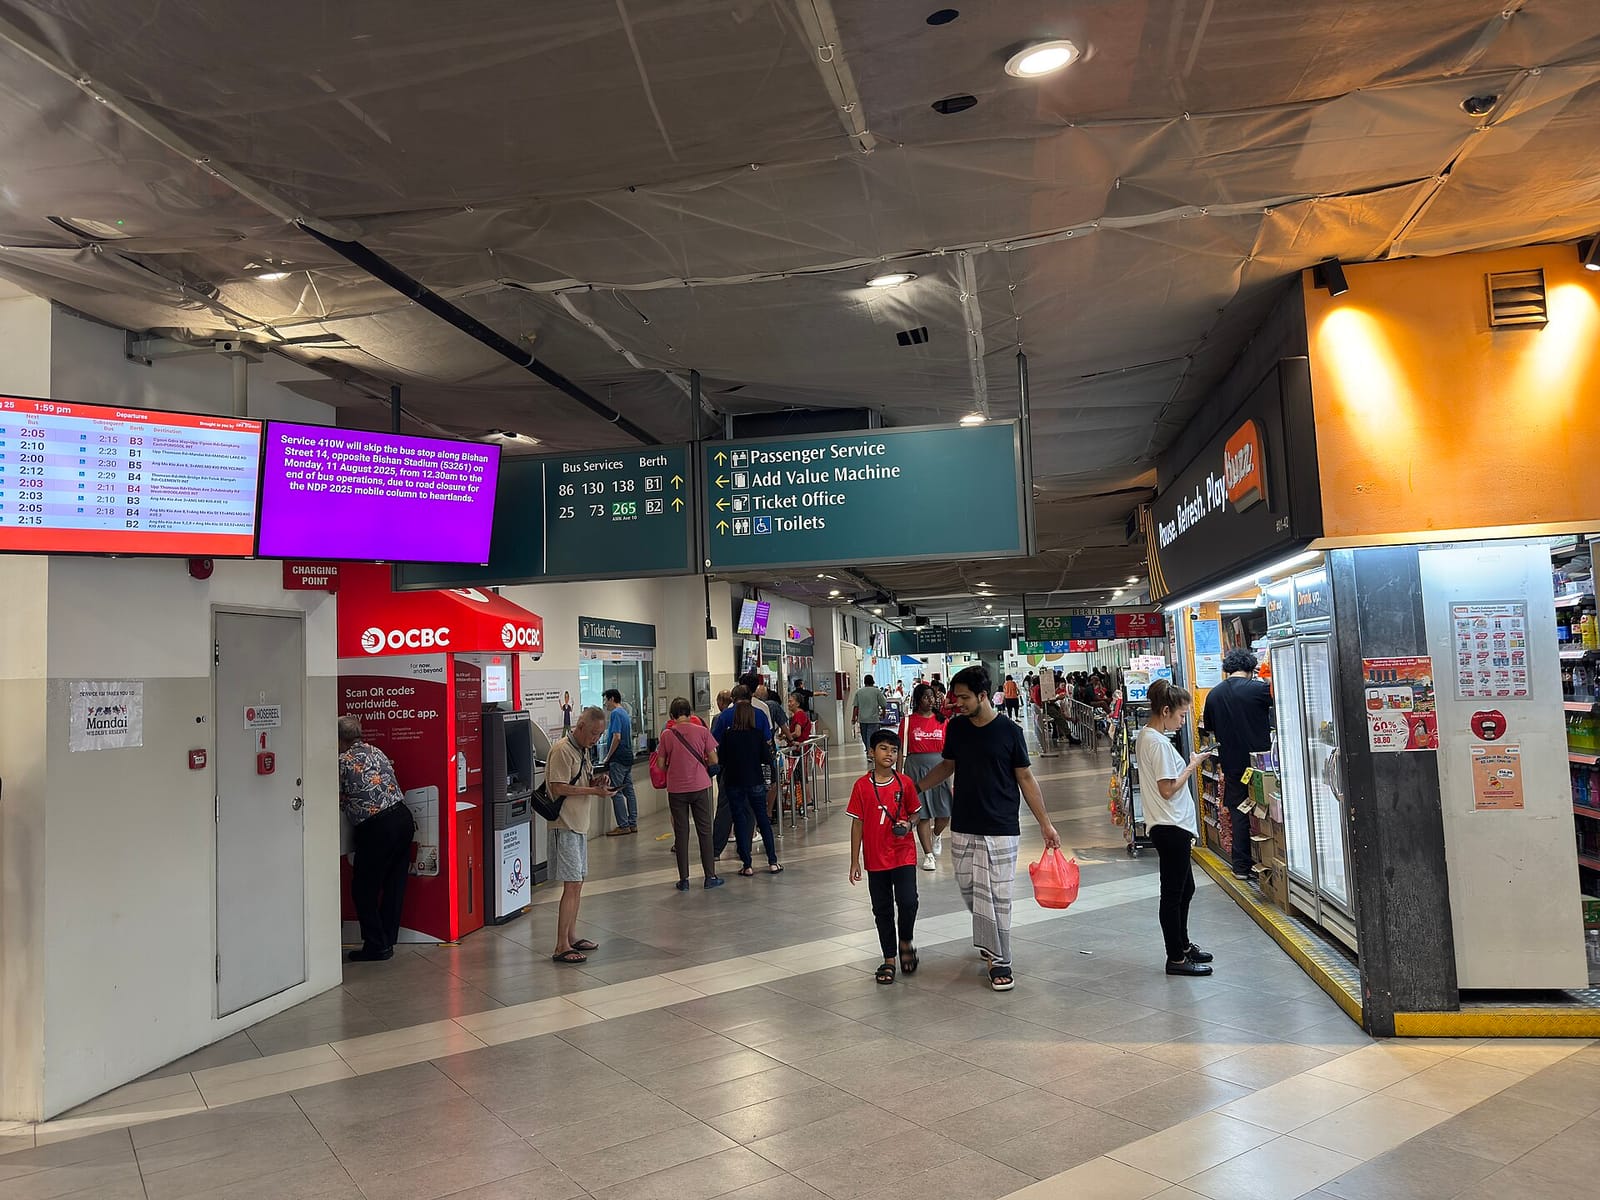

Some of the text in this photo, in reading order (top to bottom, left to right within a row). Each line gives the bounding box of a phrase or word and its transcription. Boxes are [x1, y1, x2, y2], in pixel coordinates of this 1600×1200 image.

[34, 404, 54, 412] 1:59
[20, 428, 45, 438] 2:05
[99, 435, 118, 443] 2:15
[130, 437, 143, 446] B3
[20, 441, 141, 458] 2:10 2:23 B1
[280, 434, 488, 462] Service 410W will skip the bus stop along Bishan
[751, 441, 886, 464] Passenger Service
[20, 454, 44, 463] 2:00
[129, 461, 142, 469] B5
[285, 447, 314, 457] Street
[316, 450, 330, 460] 14,
[332, 453, 370, 462] opposite
[373, 455, 402, 464] Bishan
[404, 458, 438, 468] Stadium
[440, 461, 472, 472] (53261)
[562, 460, 624, 472] Bus Services
[640, 455, 668, 468] Berth
[20, 466, 44, 476] 2:12
[284, 458, 324, 471] Monday,
[326, 462, 337, 470] 11
[340, 463, 371, 473] August
[374, 466, 398, 477] 2025,
[400, 468, 420, 477] from
[422, 470, 458, 480] 12.30am
[752, 464, 900, 487] Add Value Machine
[19, 479, 43, 488] 2:03
[128, 485, 141, 493] B4
[286, 471, 304, 479] end
[306, 471, 316, 479] of
[318, 472, 334, 481] bus
[336, 475, 385, 486] operations,
[387, 478, 403, 486] due
[436, 482, 466, 491] closure
[468, 484, 479, 492] for
[559, 479, 660, 496] 86 130 138 B1
[19, 491, 43, 500] 2:03
[290, 481, 304, 490] the
[307, 482, 327, 491] NDP
[330, 485, 352, 494] 2025
[355, 486, 384, 496] mobile
[386, 489, 417, 498] column
[430, 492, 474, 502] heartlands.
[19, 504, 42, 512] 2:05
[752, 491, 846, 510] Ticket Office
[559, 502, 661, 519] 25 73 265 B2
[1158, 472, 1228, 550] Pause. Refresh. Play.
[18, 516, 42, 524] 2:15
[126, 520, 139, 528] B2
[774, 515, 825, 532] Toilets
[292, 566, 337, 575] CHARGING
[302, 577, 328, 585] POINT
[1038, 618, 1060, 628] 265
[1085, 616, 1101, 626] 73
[1130, 614, 1146, 624] 25
[387, 627, 450, 648] OCBC
[517, 628, 540, 646] OCBC
[590, 623, 621, 638] Ticket office
[346, 686, 415, 697] Scan QR codes
[346, 699, 399, 709] worldwide.
[366, 711, 385, 720] with
[388, 709, 415, 719] OCBC
[417, 710, 438, 719] app.
[86, 716, 128, 729] Mandai
[1373, 722, 1397, 732] 60%
[878, 806, 887, 824] 7
